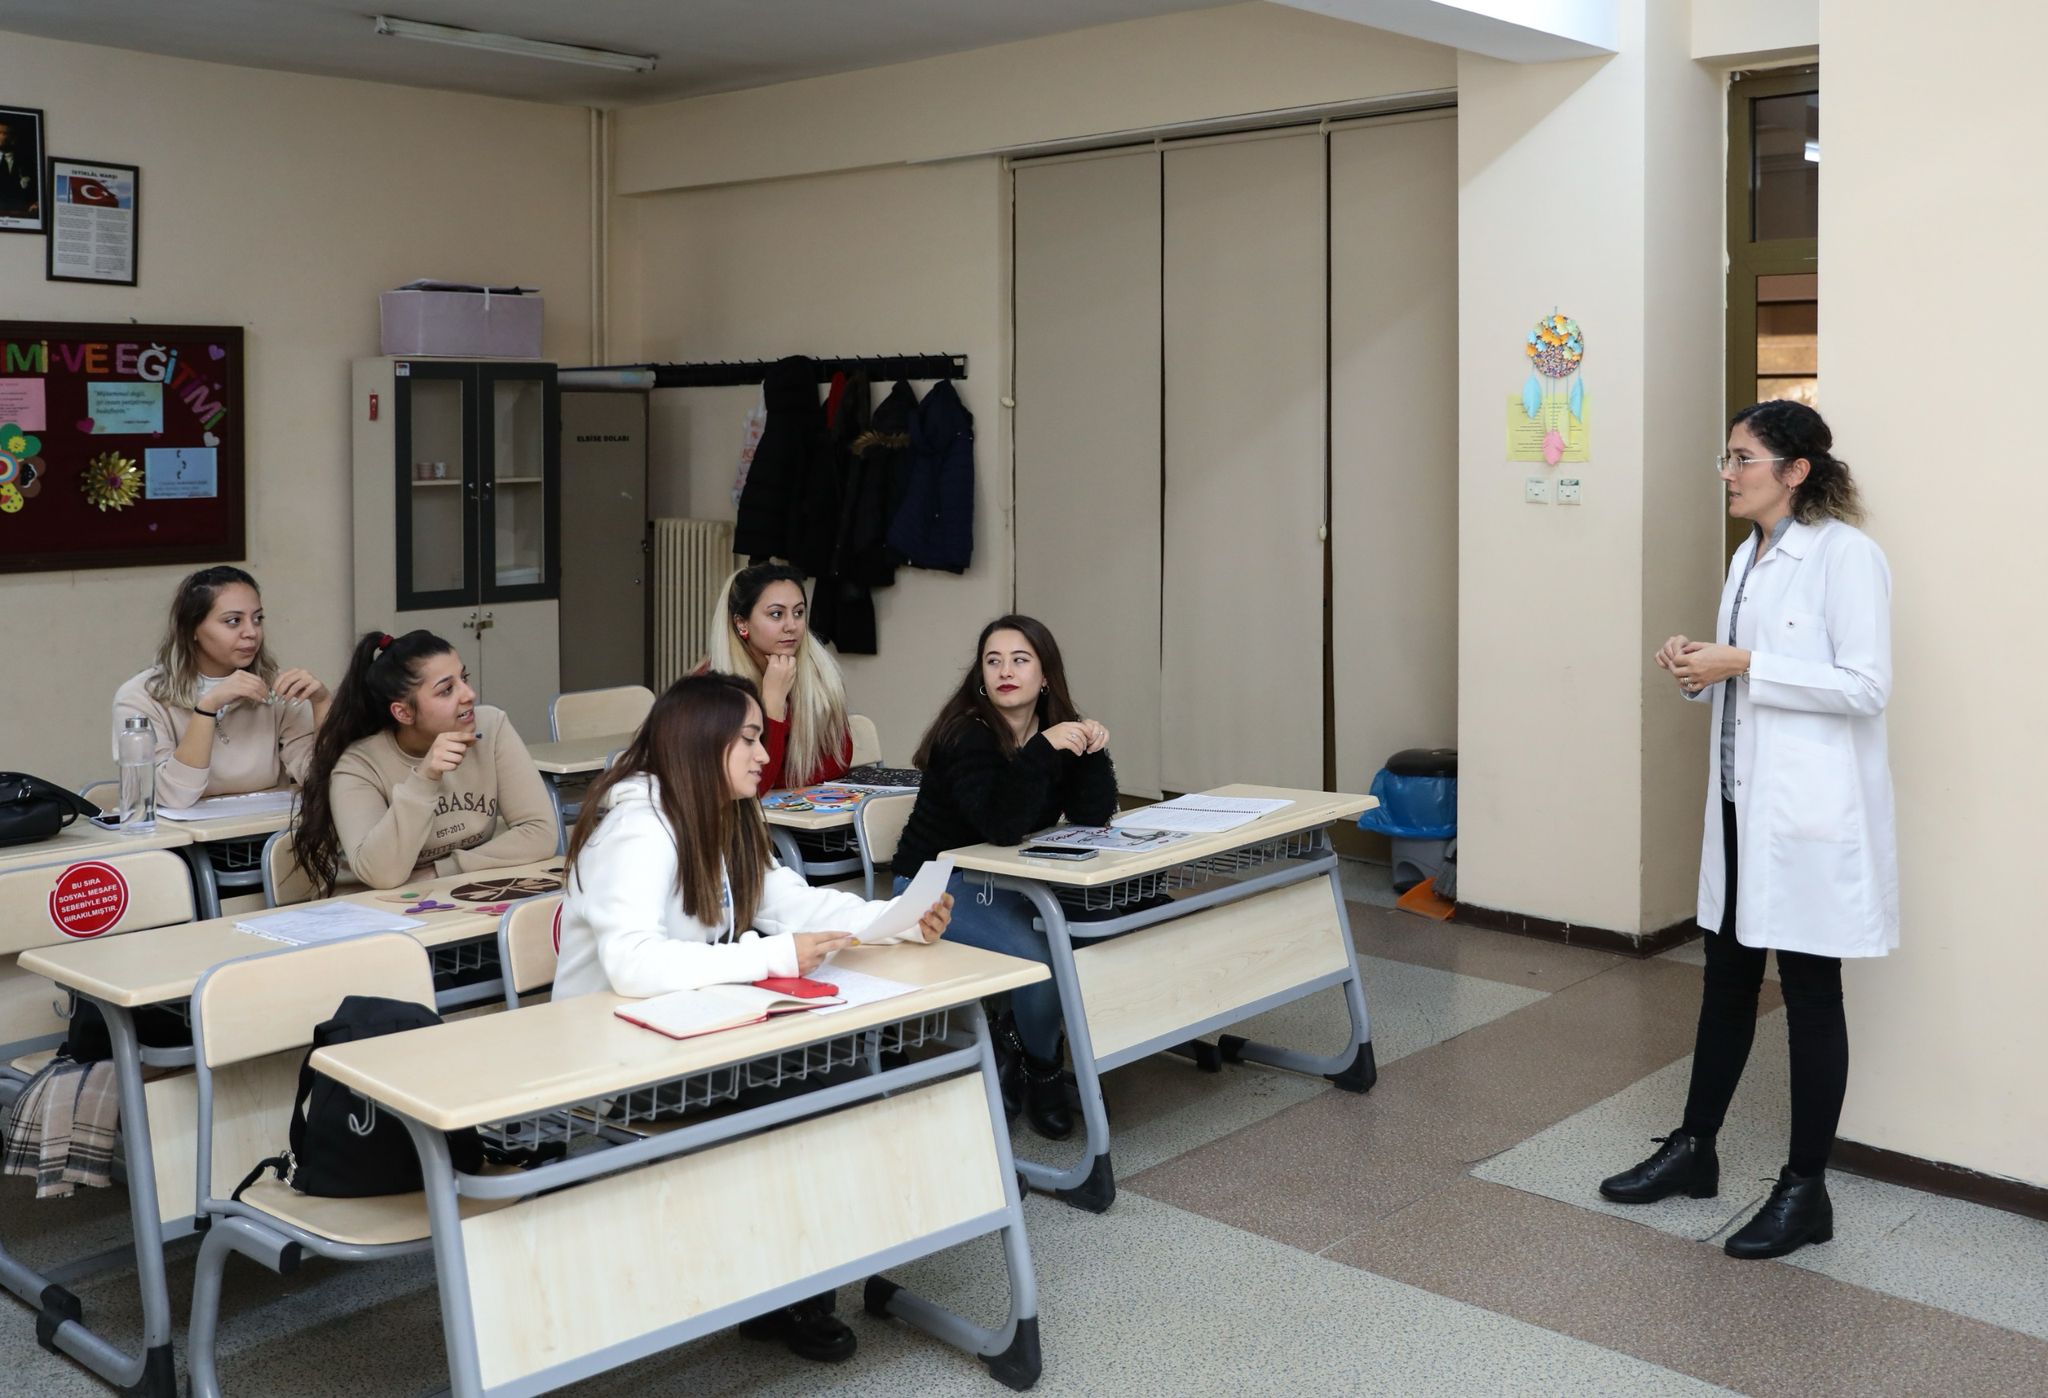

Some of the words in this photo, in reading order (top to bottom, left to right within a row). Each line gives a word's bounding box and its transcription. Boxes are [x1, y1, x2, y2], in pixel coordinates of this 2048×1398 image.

[60, 343, 110, 374] VE
[115, 342, 227, 431] EĞİTİMİ
[436, 822, 466, 839] EST-2013
[461, 831, 485, 846] FOX
[72, 881, 82, 889] BU
[84, 878, 100, 887] SIRA
[58, 892, 87, 903] SOSYAL
[88, 884, 117, 896] MESAFE
[61, 898, 101, 913] SEBEBİYLE
[101, 894, 118, 904] BOŞ
